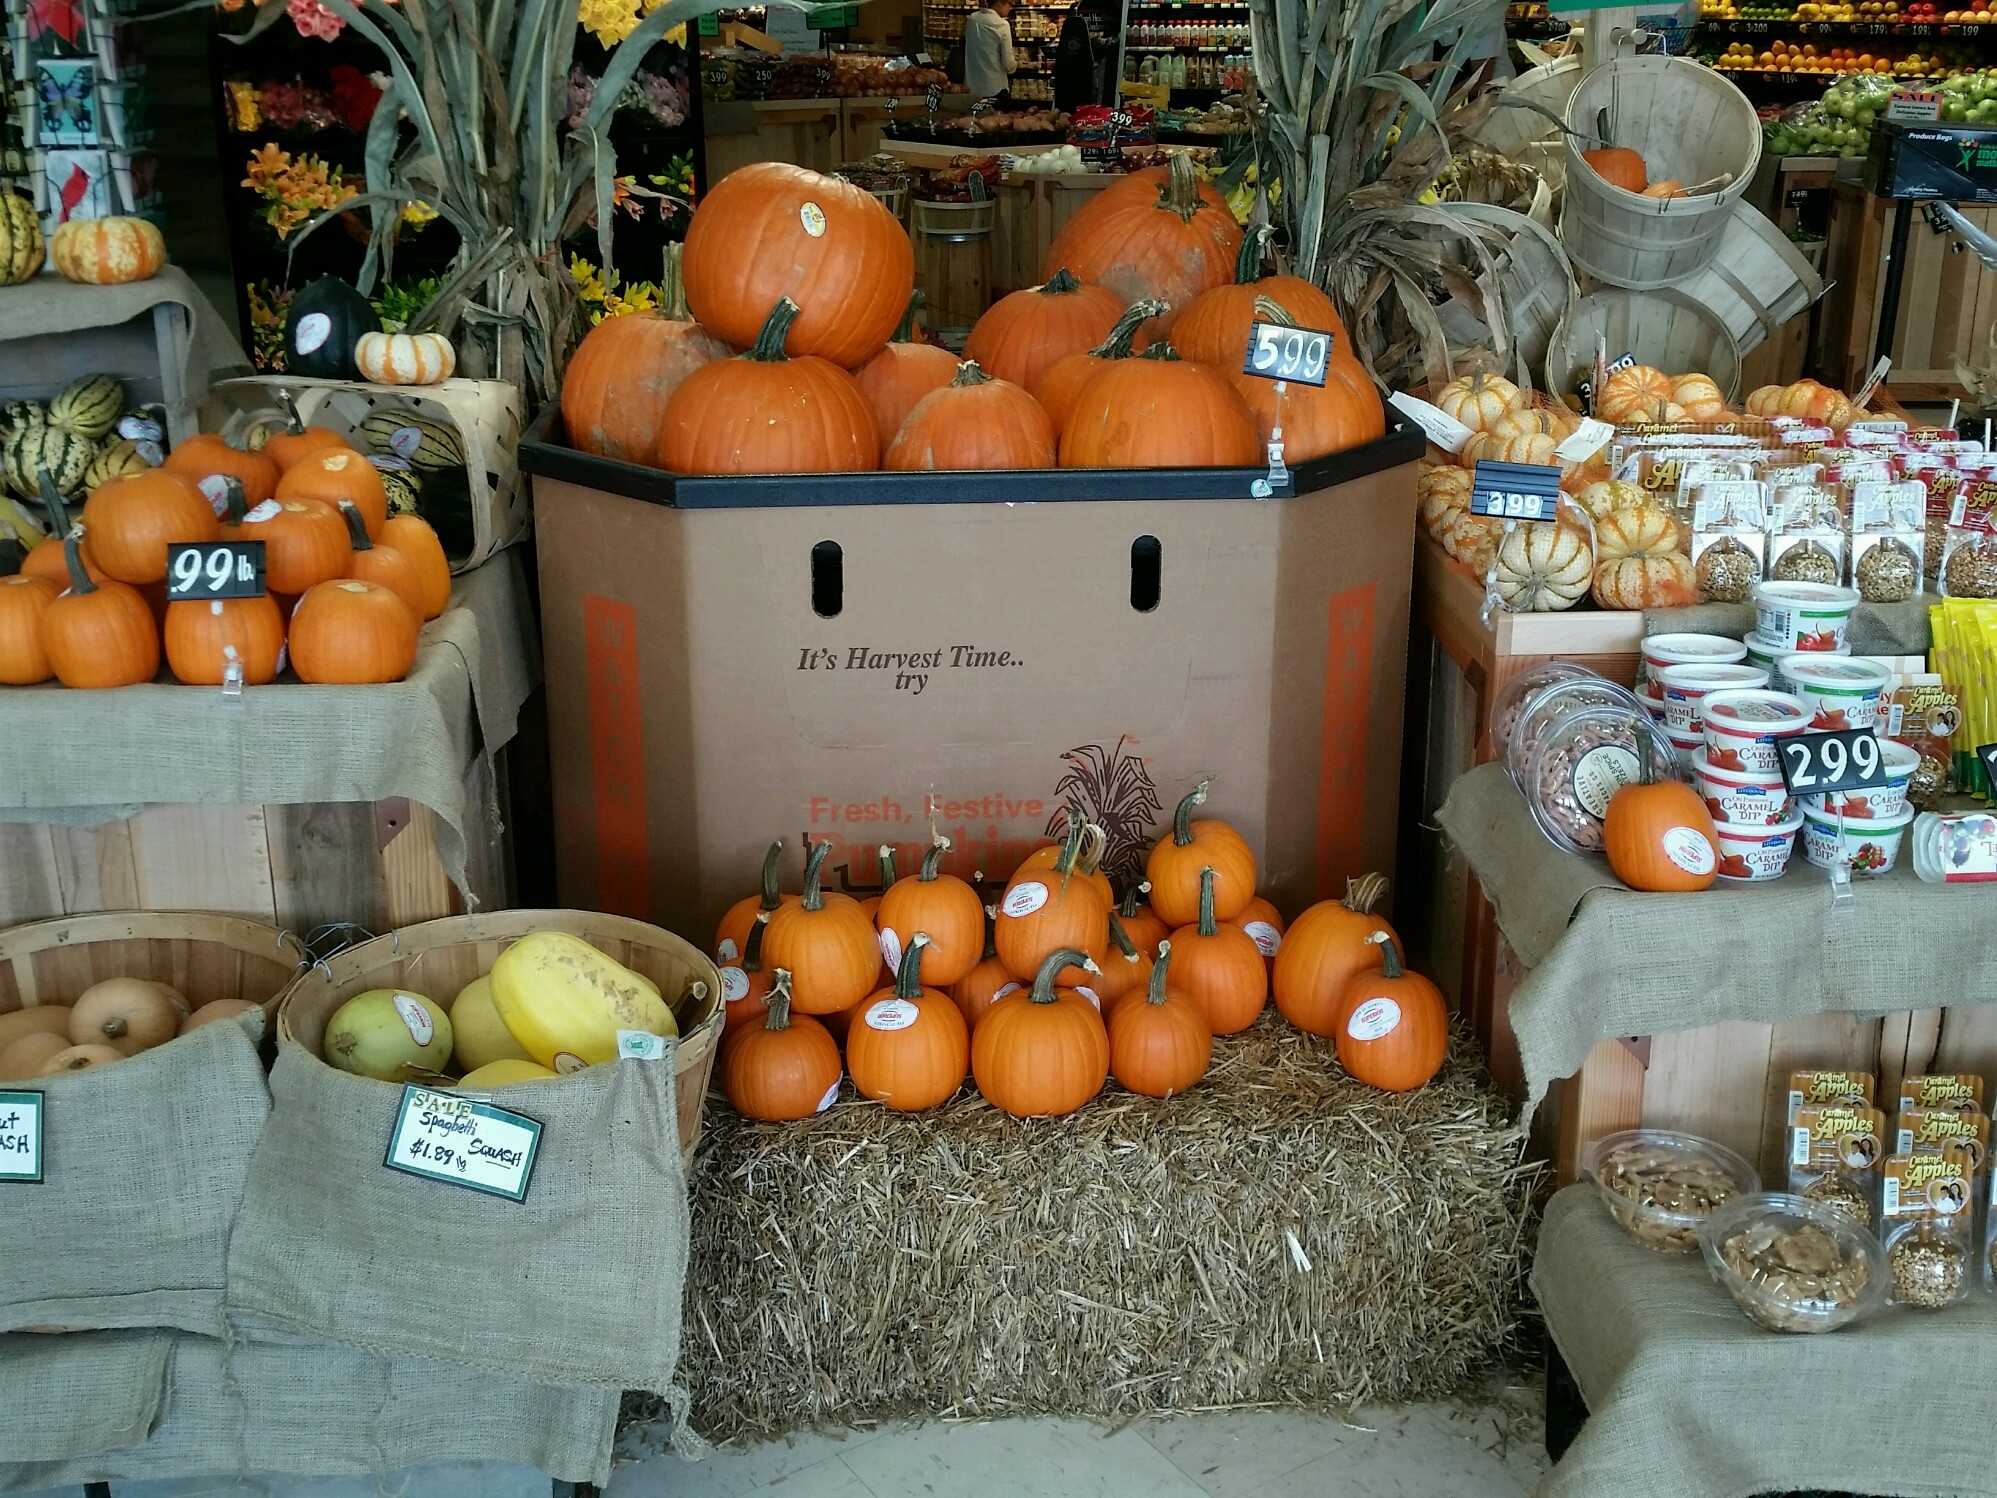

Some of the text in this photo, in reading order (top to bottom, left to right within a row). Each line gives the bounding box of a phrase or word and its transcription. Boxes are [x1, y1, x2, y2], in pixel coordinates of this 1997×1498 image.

[1962, 26, 1979, 36] 199
[710, 72, 727, 82] 399
[1111, 111, 1132, 126] 399
[1908, 132, 1953, 142] Produce Bags
[1254, 329, 1326, 379] 5.99
[238, 554, 254, 582] lb.
[797, 648, 837, 670] It's
[844, 647, 942, 669] Harvest
[895, 670, 929, 695] try
[1913, 686, 1943, 698] Caramel
[1904, 691, 1958, 715] Apples
[1667, 705, 1701, 719] ARAMEL
[1670, 714, 1685, 725] DIP
[1786, 735, 1879, 787] 2.99
[811, 792, 1043, 823] Fresh, Festive
[1721, 797, 1778, 812] CARAMEL
[1739, 810, 1761, 820] DIP
[1814, 847, 1834, 860] DIP
[1763, 860, 1780, 872] DIP
[1813, 1072, 1846, 1084] Caramel
[1924, 1076, 1956, 1090] Caramel
[1804, 1080, 1864, 1103] Apples
[1916, 1083, 1974, 1107] Apples
[412, 1091, 473, 1119] SALE
[1820, 1108, 1854, 1120] Caramel
[1925, 1111, 1960, 1123] Caramel
[419, 1111, 479, 1137] Spaghetti
[1810, 1116, 1873, 1140] Apples
[1914, 1120, 1978, 1143] Apples
[409, 1137, 454, 1165] $1.89
[1909, 1154, 1943, 1168] Caramel
[1900, 1160, 1962, 1189] Apples
